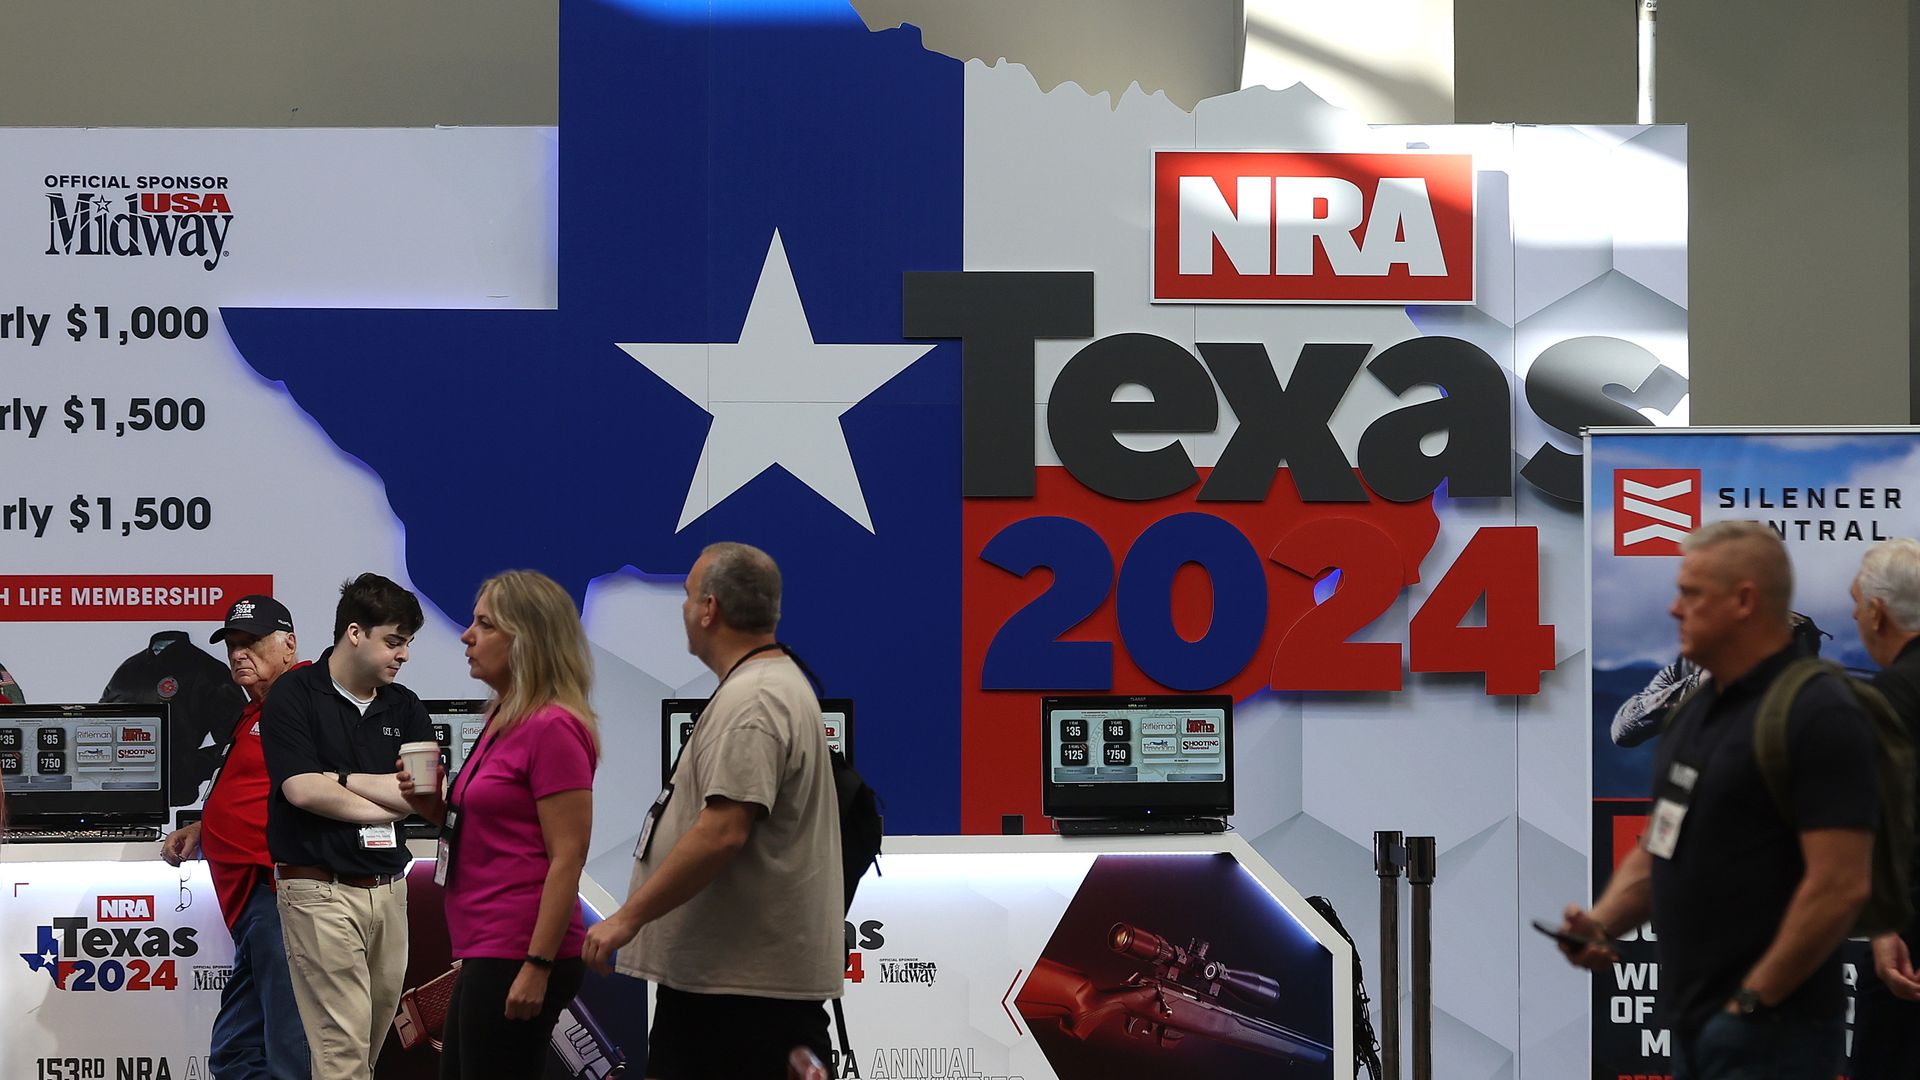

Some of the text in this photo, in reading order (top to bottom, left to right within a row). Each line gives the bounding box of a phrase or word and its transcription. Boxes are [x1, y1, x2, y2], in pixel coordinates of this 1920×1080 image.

[44, 175, 229, 189] OFFICIAL SPONSOR
[141, 193, 232, 213] USA
[1178, 175, 1448, 277] NRA
[67, 303, 208, 346] $1,000
[903, 271, 1657, 503] Texas
[64, 395, 206, 437] $1,500
[1719, 487, 1902, 509] SILENCER
[69, 494, 211, 537] $1,500
[1720, 520, 1887, 541] NTRAL
[19, 588, 62, 606] LIFE
[71, 587, 224, 606] MEMBERSHIP
[979, 512, 1556, 696] 2024
[43, 734, 58, 745] $85
[1066, 726, 1081, 736] $35
[1108, 725, 1124, 736] $85
[117, 749, 155, 759] SHOOTING
[1064, 749, 1083, 760] $125
[1107, 749, 1126, 760] $750
[1182, 740, 1219, 750] SHOOTING
[41, 758, 61, 769] $750
[100, 899, 151, 918] NRA
[53, 917, 199, 957] Texas
[71, 960, 178, 991] 2024
[1610, 996, 1656, 1024] OF
[36, 1057, 104, 1080] 153RD
[117, 1056, 172, 1080] NRA
[870, 1047, 983, 1079] ANNUAL
